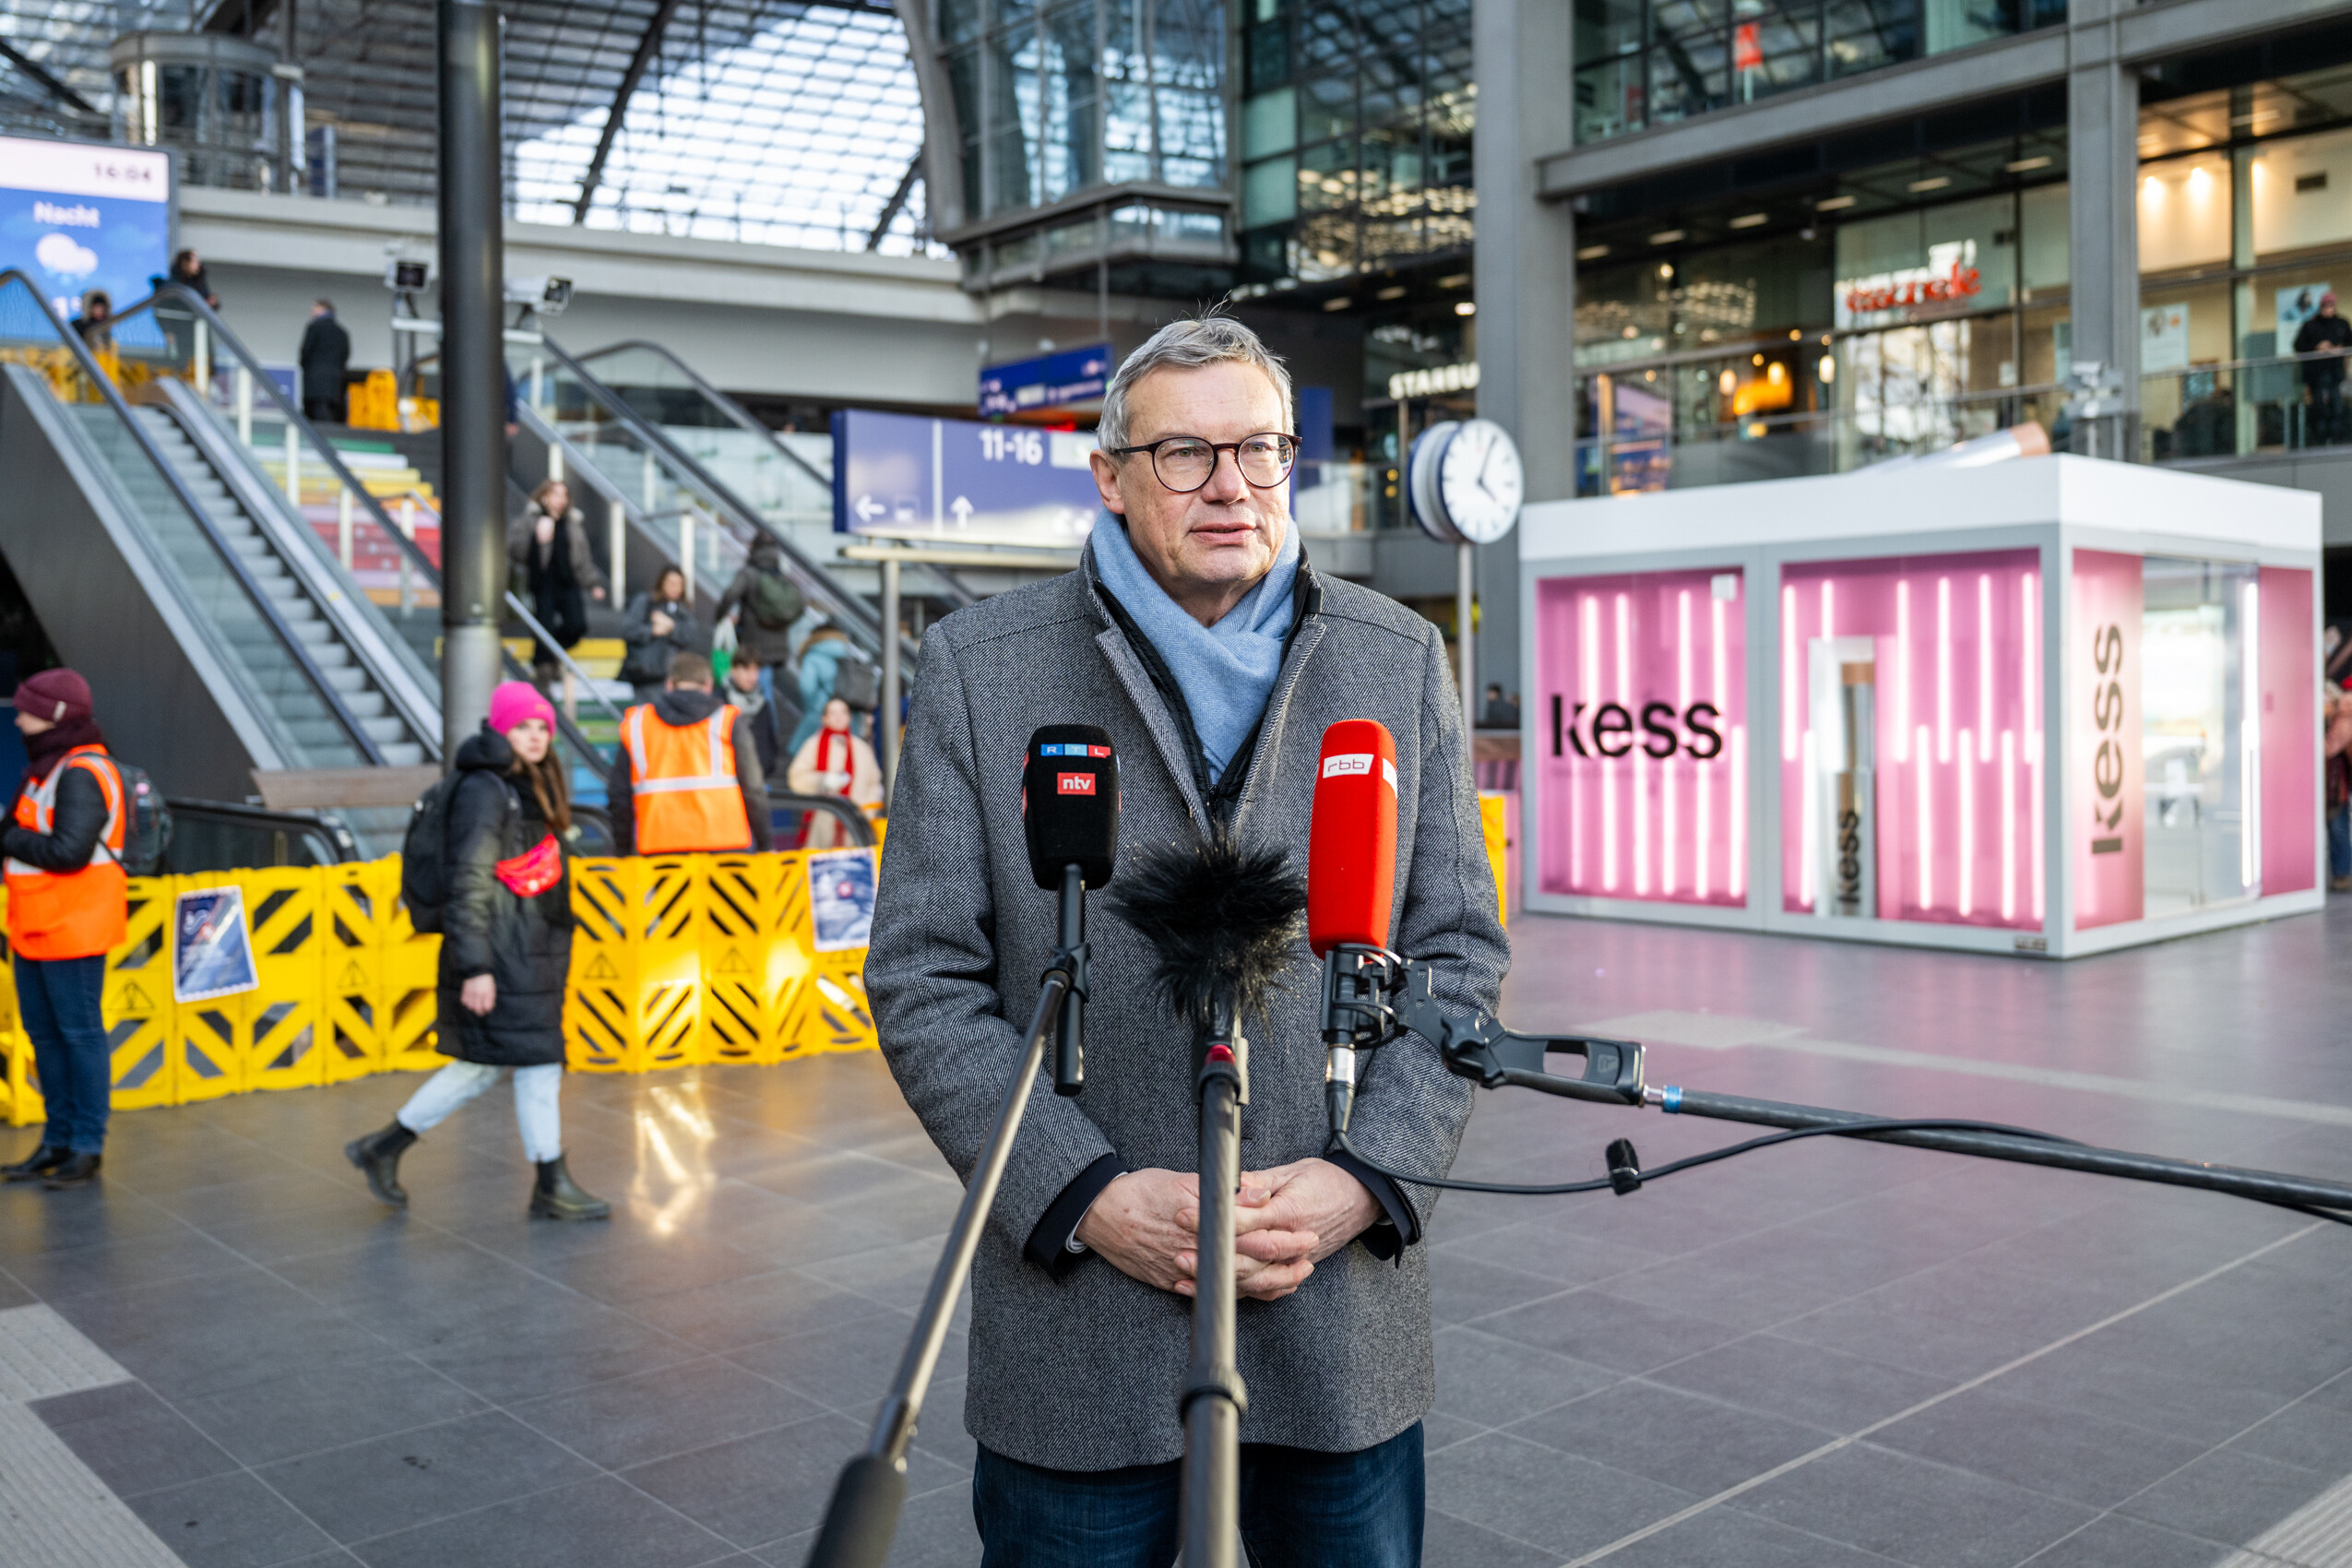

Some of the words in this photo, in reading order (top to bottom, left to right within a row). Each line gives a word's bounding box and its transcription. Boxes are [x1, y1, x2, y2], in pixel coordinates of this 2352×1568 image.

[33, 200, 101, 229] Nacht
[1388, 362, 1480, 400] STARBU
[979, 428, 1043, 466] 11-16
[1550, 695, 1723, 759] kess
[2090, 624, 2123, 854] kess
[1046, 745, 1105, 756] RTL
[1327, 758, 1365, 772] rbb
[1063, 776, 1091, 790] ntv
